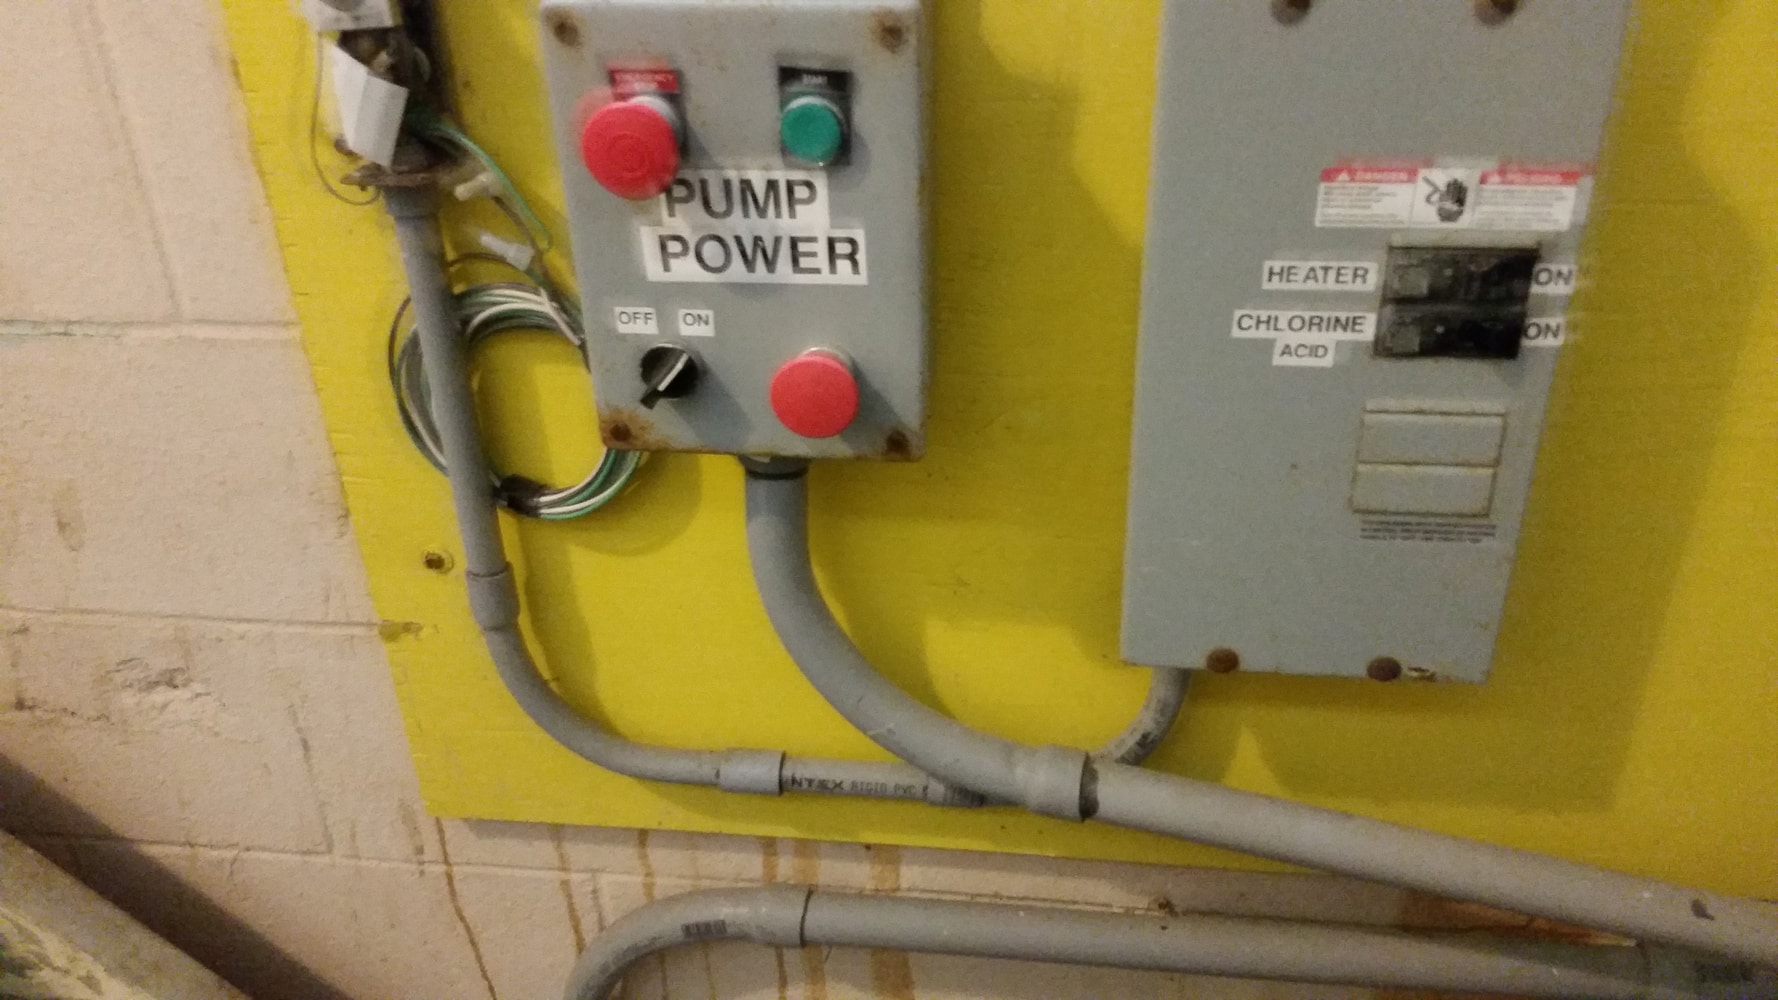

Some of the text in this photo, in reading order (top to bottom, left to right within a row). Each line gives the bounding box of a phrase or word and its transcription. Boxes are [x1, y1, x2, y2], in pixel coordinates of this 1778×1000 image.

[664, 178, 818, 219] PUMP
[658, 233, 861, 275] POWER
[1267, 265, 1370, 284] HEATER
[1535, 267, 1574, 286] ON
[619, 311, 654, 326] OFF
[682, 312, 710, 327] ON
[1236, 313, 1367, 333] CHLORINE
[1525, 322, 1561, 340] ON
[1280, 343, 1329, 359] ACID
